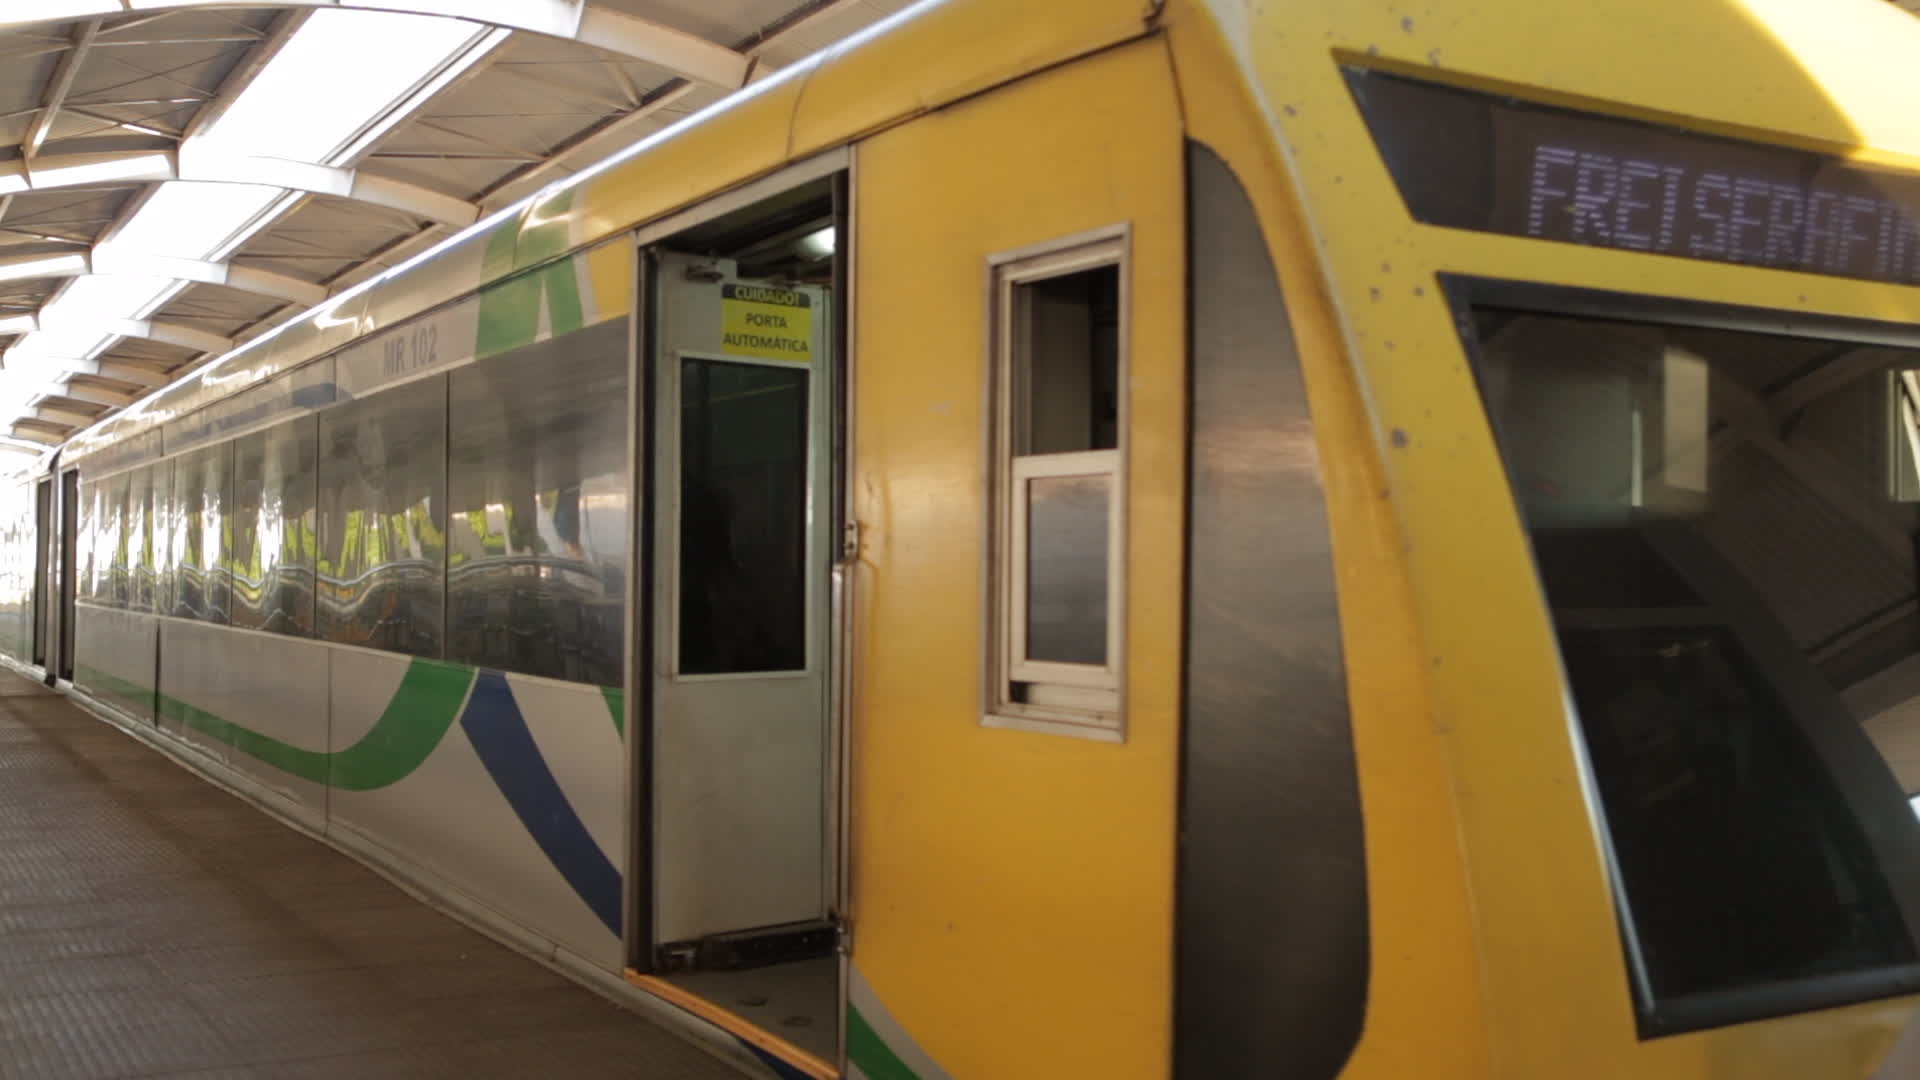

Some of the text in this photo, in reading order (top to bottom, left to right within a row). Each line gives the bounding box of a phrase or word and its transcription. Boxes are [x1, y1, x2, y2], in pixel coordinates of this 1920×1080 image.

[1527, 145, 1684, 251] FREI
[735, 287, 800, 305] CUIDADO!
[745, 312, 788, 328] PORTA
[411, 323, 438, 367] 102
[723, 332, 809, 353] AUTOMÁTICA
